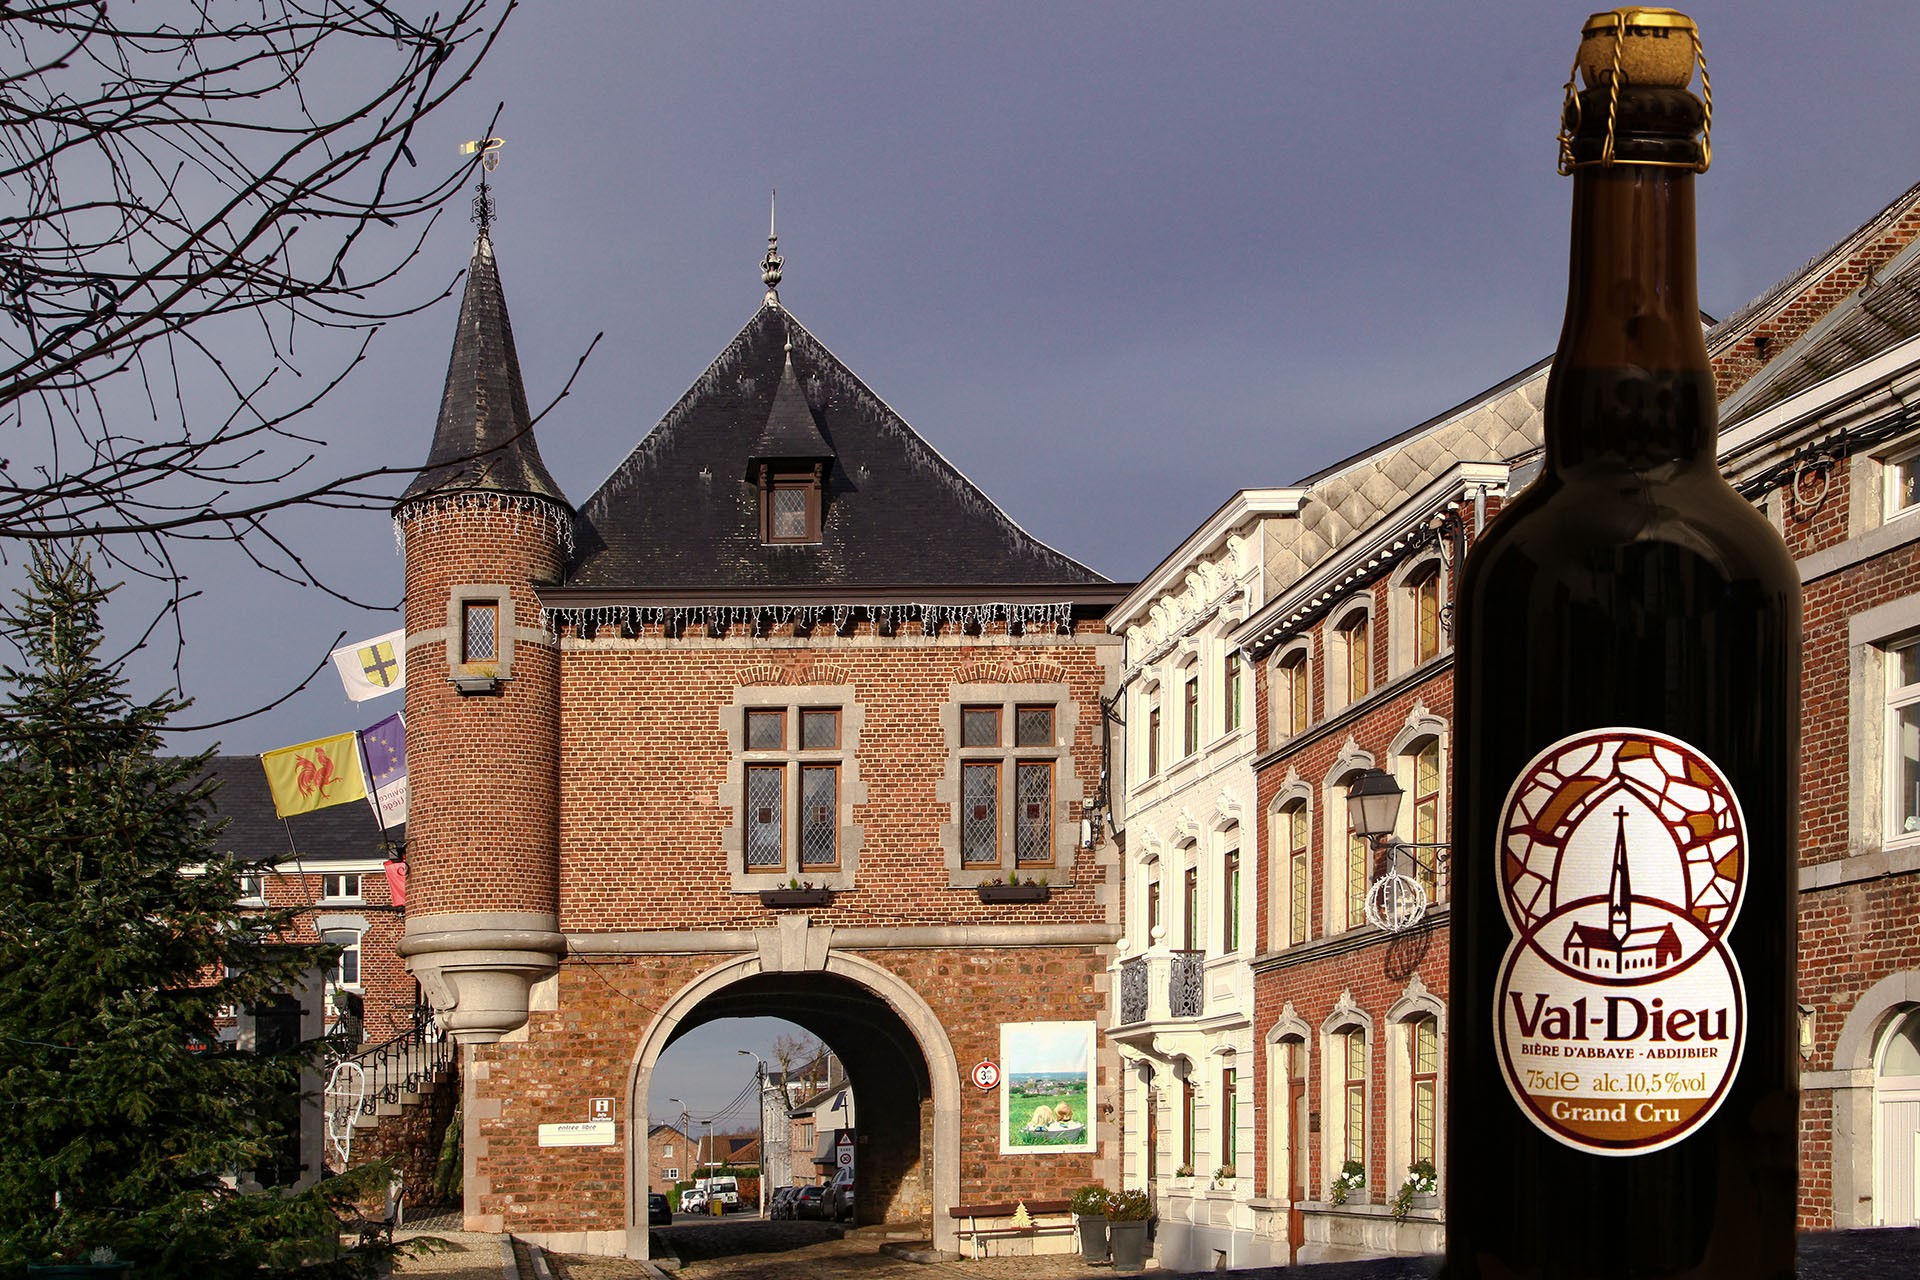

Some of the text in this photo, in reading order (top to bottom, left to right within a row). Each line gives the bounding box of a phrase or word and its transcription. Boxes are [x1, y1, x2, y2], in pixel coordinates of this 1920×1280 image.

[1509, 991, 1729, 1042] Val-Dieu
[1521, 1043, 1560, 1057] BIÈRE
[1564, 1047, 1634, 1059] D'ABBAYE
[1646, 1047, 1718, 1059] ABDIJBIER
[1551, 1101, 1680, 1122] Grand Cru
